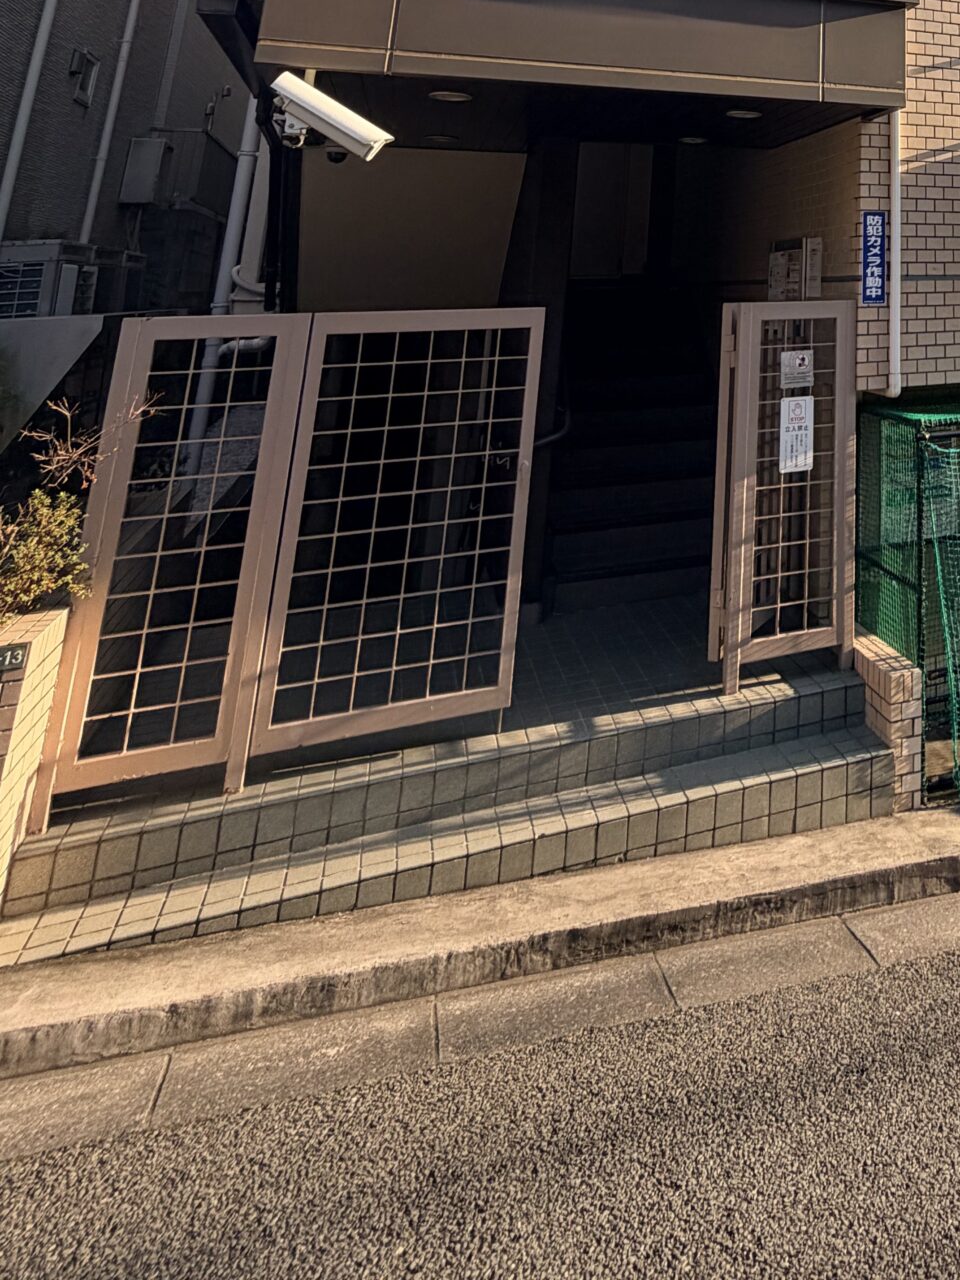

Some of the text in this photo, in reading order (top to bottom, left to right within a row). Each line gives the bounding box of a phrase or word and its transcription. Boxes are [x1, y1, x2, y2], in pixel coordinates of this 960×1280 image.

[866, 215, 882, 298] 防犯カメラ作動中
